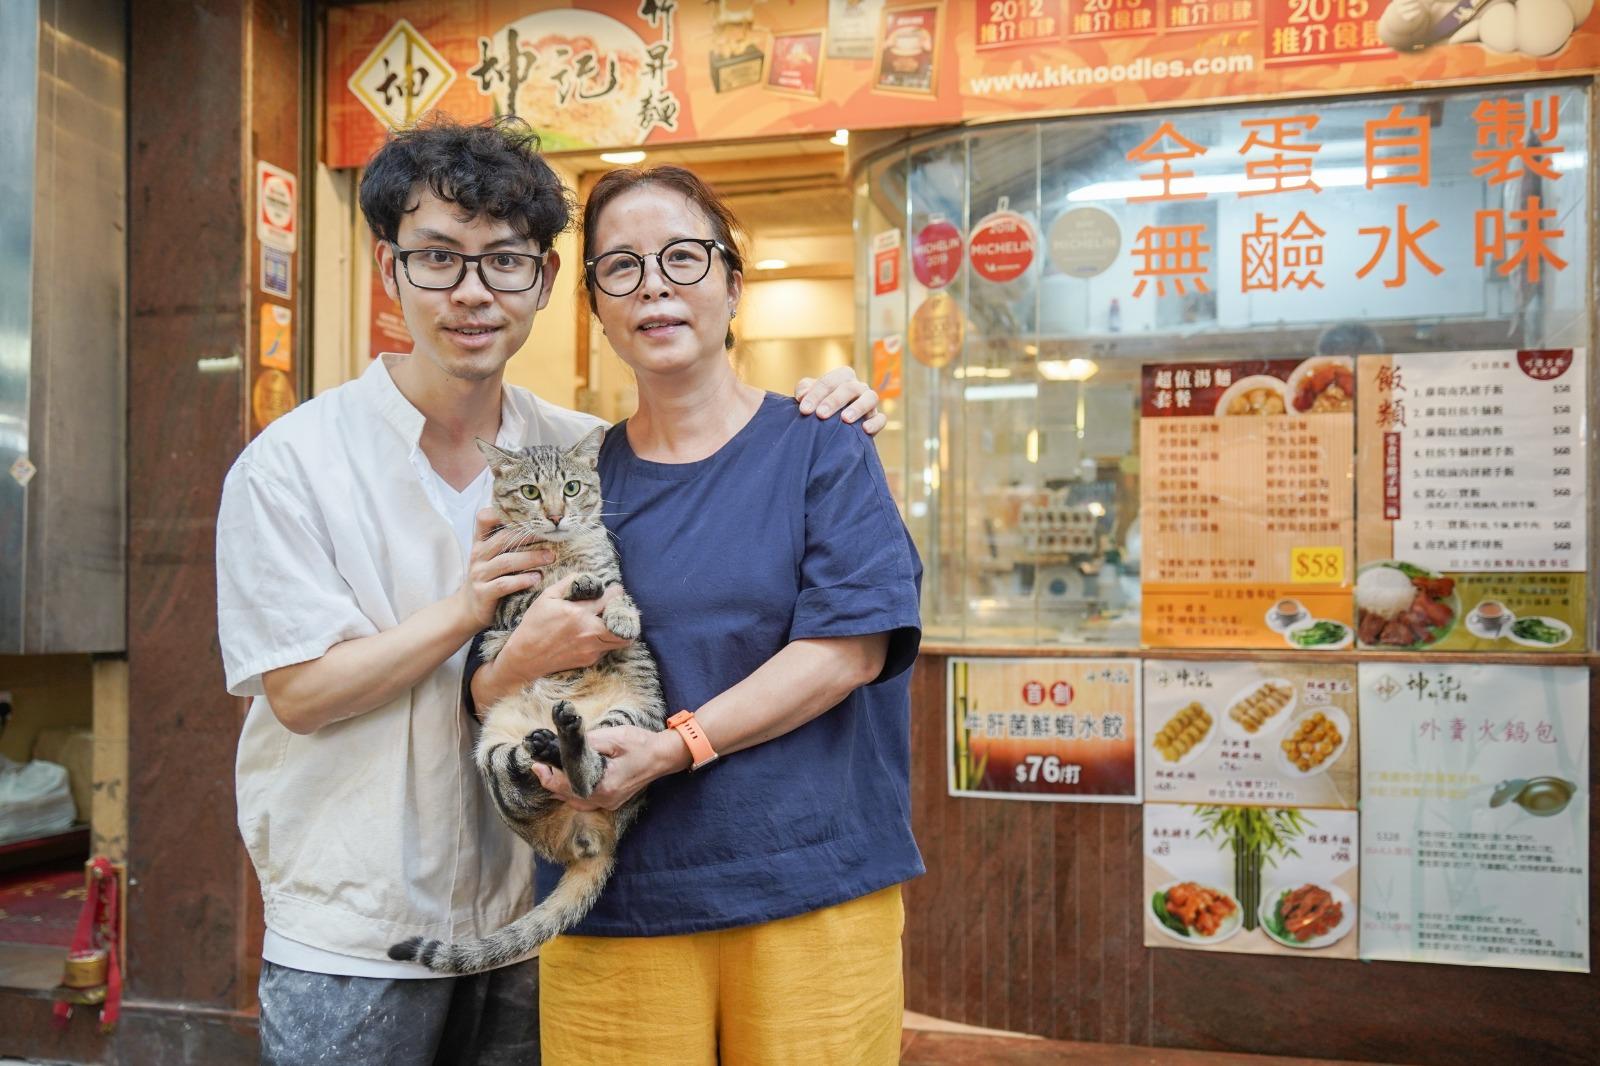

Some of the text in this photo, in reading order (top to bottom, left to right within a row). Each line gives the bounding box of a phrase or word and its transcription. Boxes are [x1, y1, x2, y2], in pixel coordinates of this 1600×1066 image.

[1288, 0, 1368, 23] 2015
[471, 29, 617, 116] 坤記
[971, 54, 1253, 95] www.kknoodles.com
[1126, 94, 1567, 204] 全蛋自製
[971, 241, 1034, 256] MICHELIN
[1131, 195, 1570, 298] 無鹼水味
[1296, 552, 1339, 578] $58
[1420, 718, 1557, 744] 外賣火鍋包
[1016, 756, 1081, 784] $76/打
